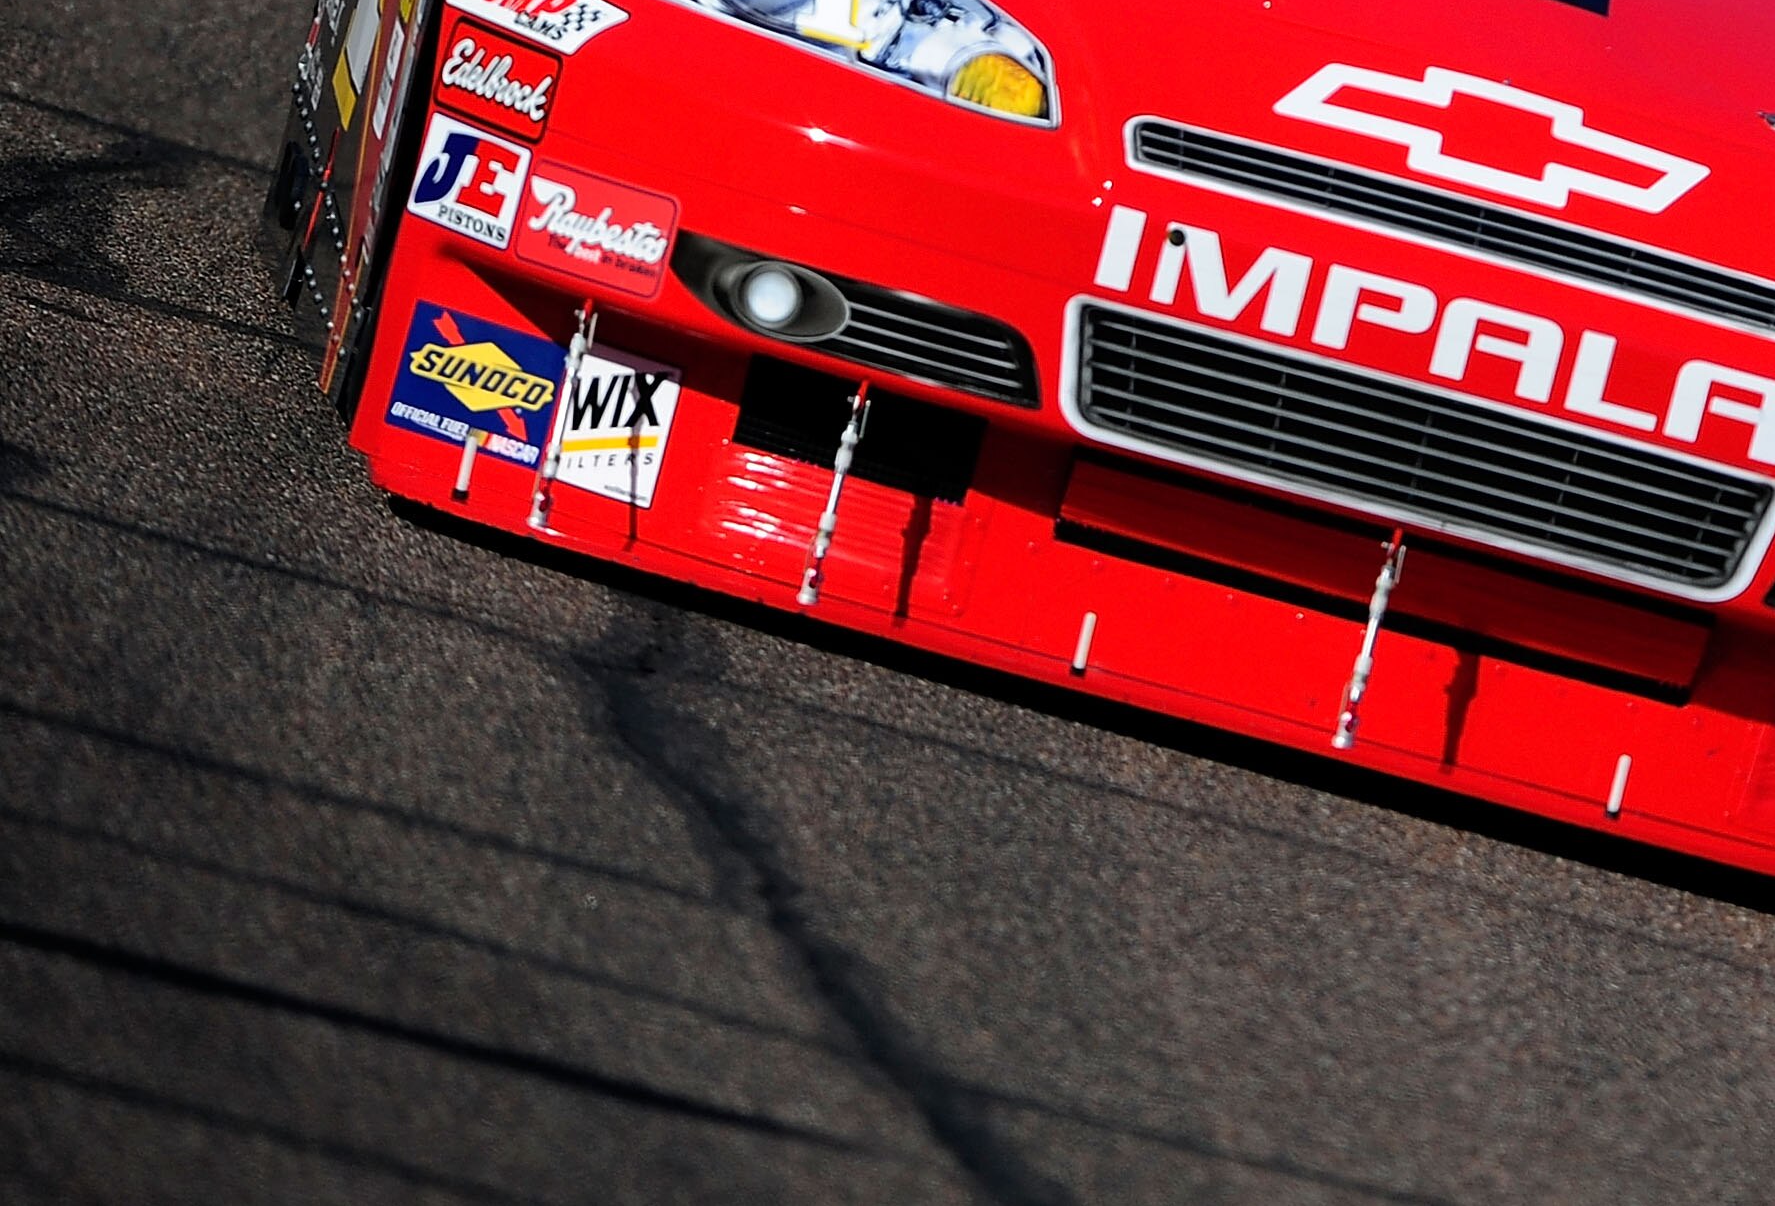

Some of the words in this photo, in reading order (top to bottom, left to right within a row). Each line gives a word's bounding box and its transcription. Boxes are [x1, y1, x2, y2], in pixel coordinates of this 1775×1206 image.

[442, 38, 553, 122] Edelbrock
[414, 132, 521, 219] JE
[427, 202, 508, 242] PISTONS
[528, 174, 669, 266] Raybestos
[416, 349, 550, 406] SUNOCO
[569, 369, 668, 430] WIX
[390, 401, 440, 428] OFFICIAL
[440, 416, 470, 436] FUEL
[486, 432, 541, 465] NASCAR
[558, 452, 655, 476] ILTERS
